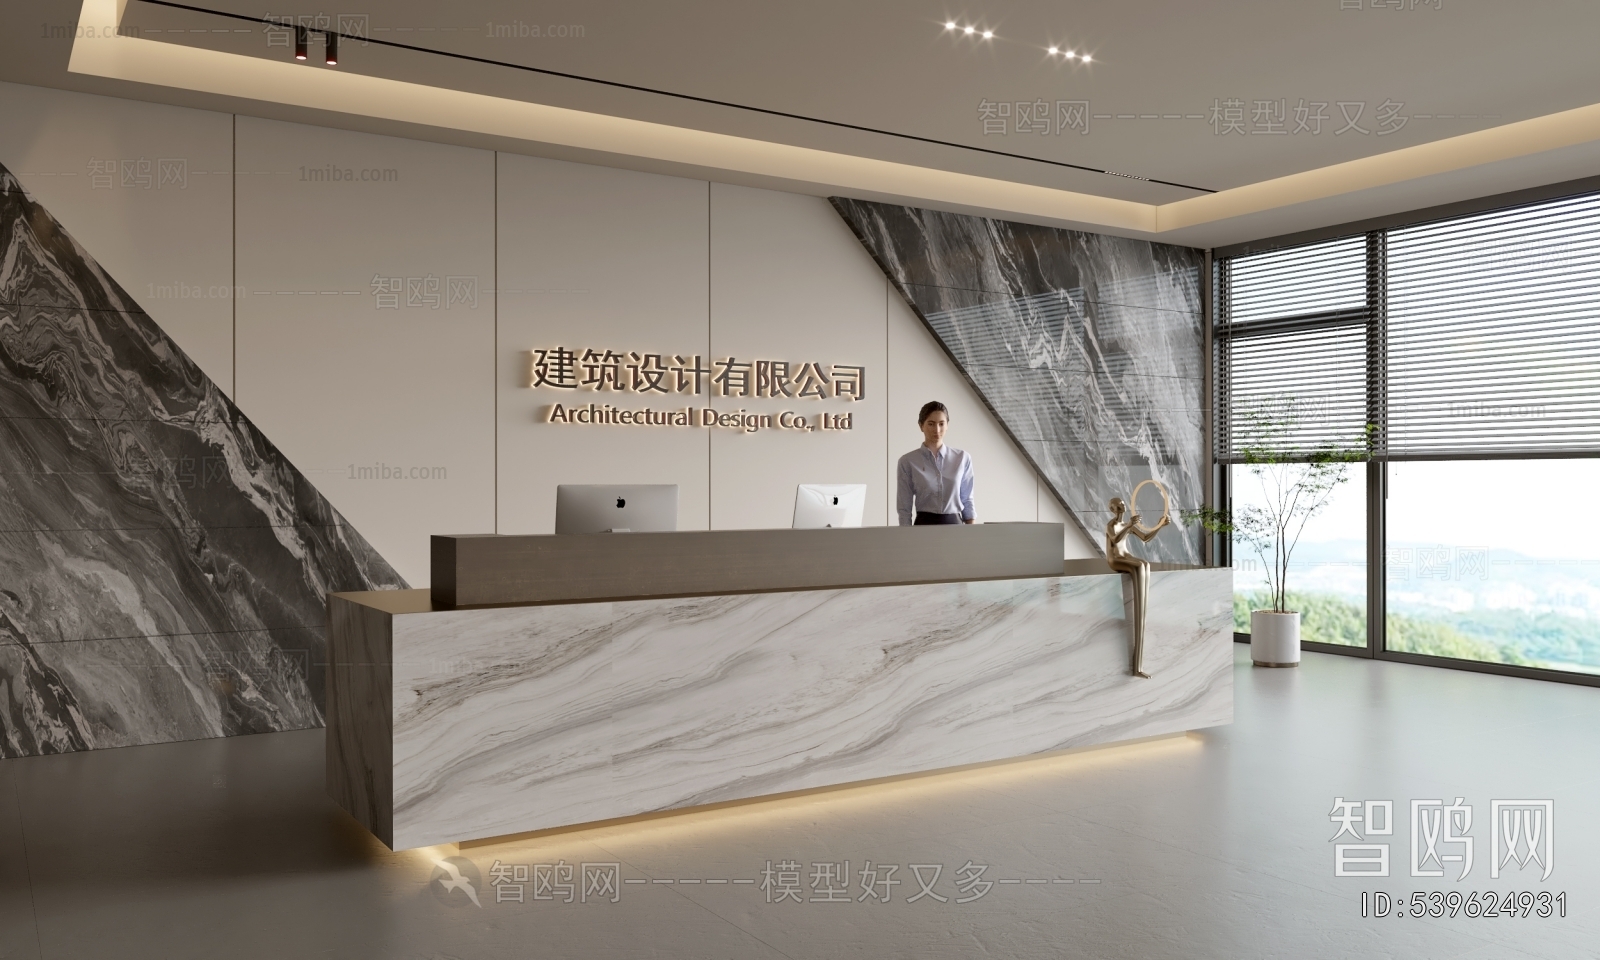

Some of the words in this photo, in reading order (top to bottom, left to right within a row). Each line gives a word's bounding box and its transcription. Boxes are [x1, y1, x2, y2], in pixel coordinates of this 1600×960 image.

[532, 346, 867, 402] 建筑设计有限公司
[549, 403, 694, 427] Architectural
[702, 408, 773, 433] Design
[822, 412, 854, 431] Ltd
